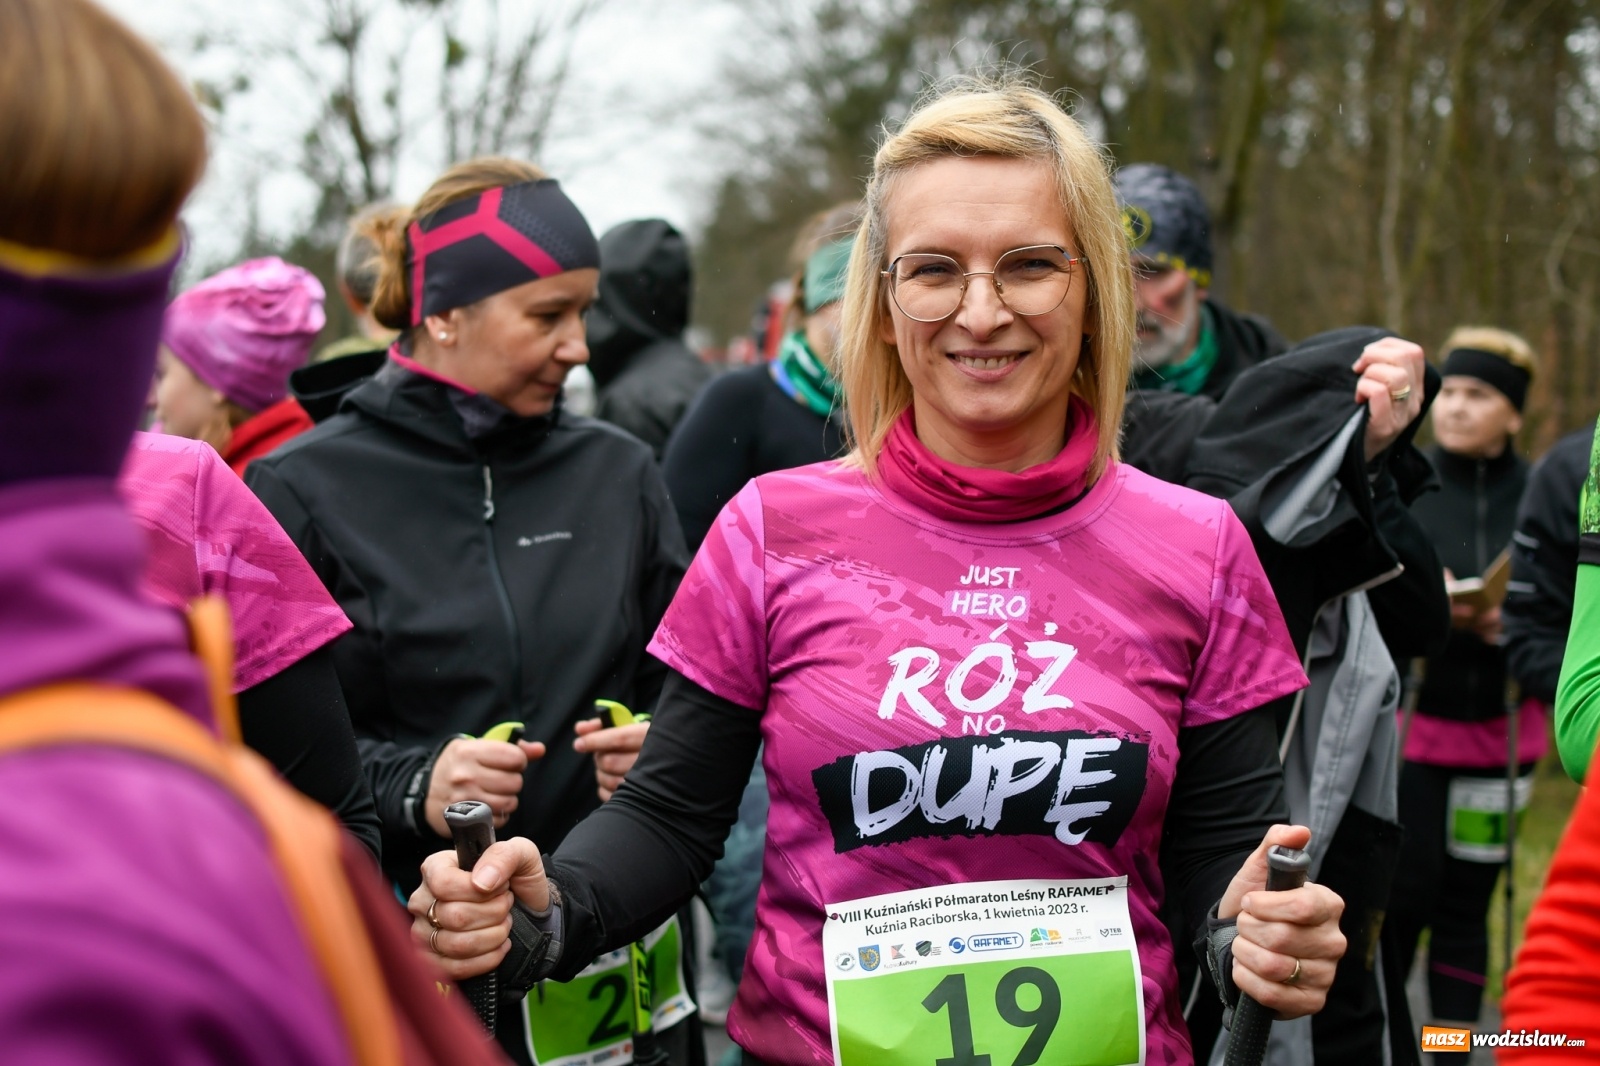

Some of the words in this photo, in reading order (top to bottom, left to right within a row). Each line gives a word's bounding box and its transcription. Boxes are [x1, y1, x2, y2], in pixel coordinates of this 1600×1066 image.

[960, 564, 1021, 588] JUST
[951, 591, 1027, 619] HERO
[877, 622, 1078, 728] RÓŻ
[962, 714, 1007, 735] NO
[851, 737, 1122, 846] DUPĘ
[839, 910, 862, 924] VIII
[864, 897, 933, 920] Kuźniański
[935, 891, 1008, 908] Półmaraton
[1011, 889, 1045, 902] Leśny
[1048, 886, 1110, 899] RAFAMET
[865, 921, 907, 936] Kuźnia
[909, 910, 982, 928] Raciborska,
[984, 908, 990, 919] 1
[993, 905, 1045, 919] kwietnia
[1047, 903, 1078, 915] 2023
[1081, 904, 1089, 913] r.
[973, 936, 1019, 948] RAFAMET
[921, 966, 1062, 1066] 19
